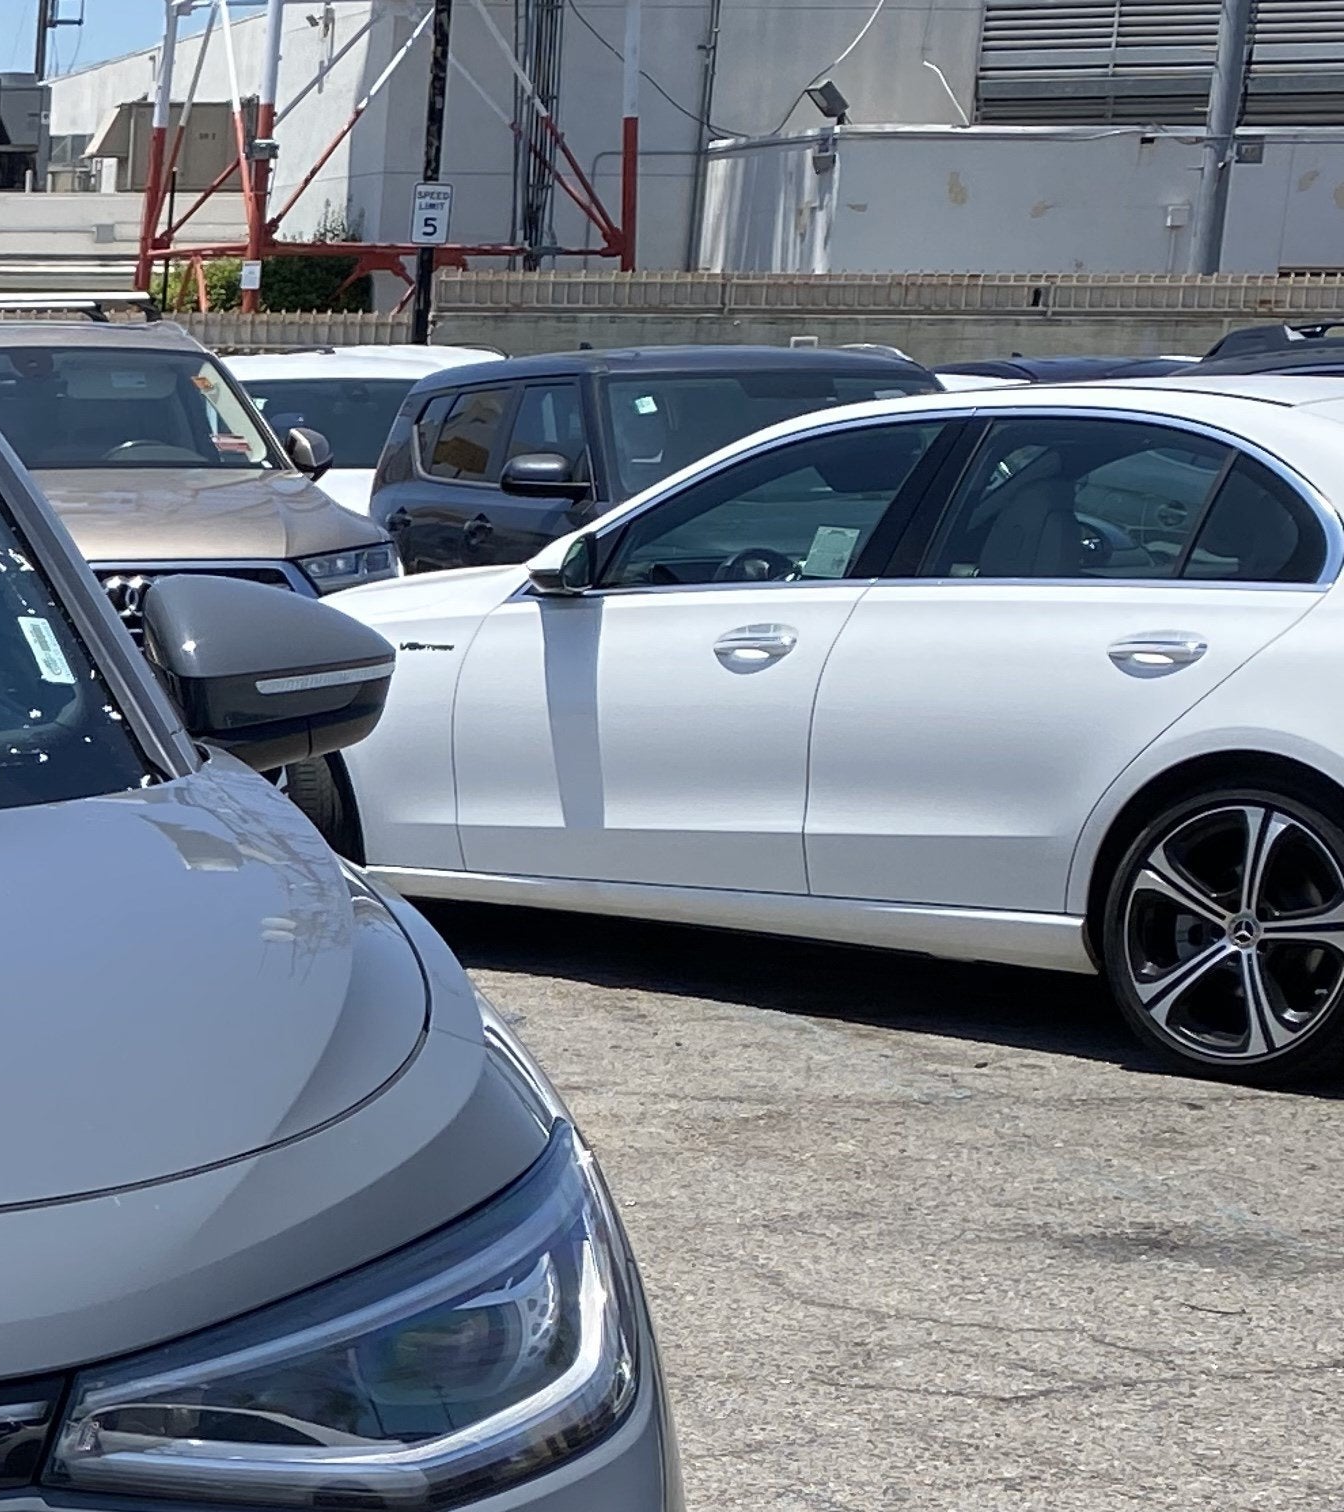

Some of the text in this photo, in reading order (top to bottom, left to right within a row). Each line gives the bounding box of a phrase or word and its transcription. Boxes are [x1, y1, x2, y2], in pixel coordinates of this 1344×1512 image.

[417, 190, 450, 200] SPEED
[418, 201, 445, 210] LIMIT
[422, 217, 438, 236] 5
